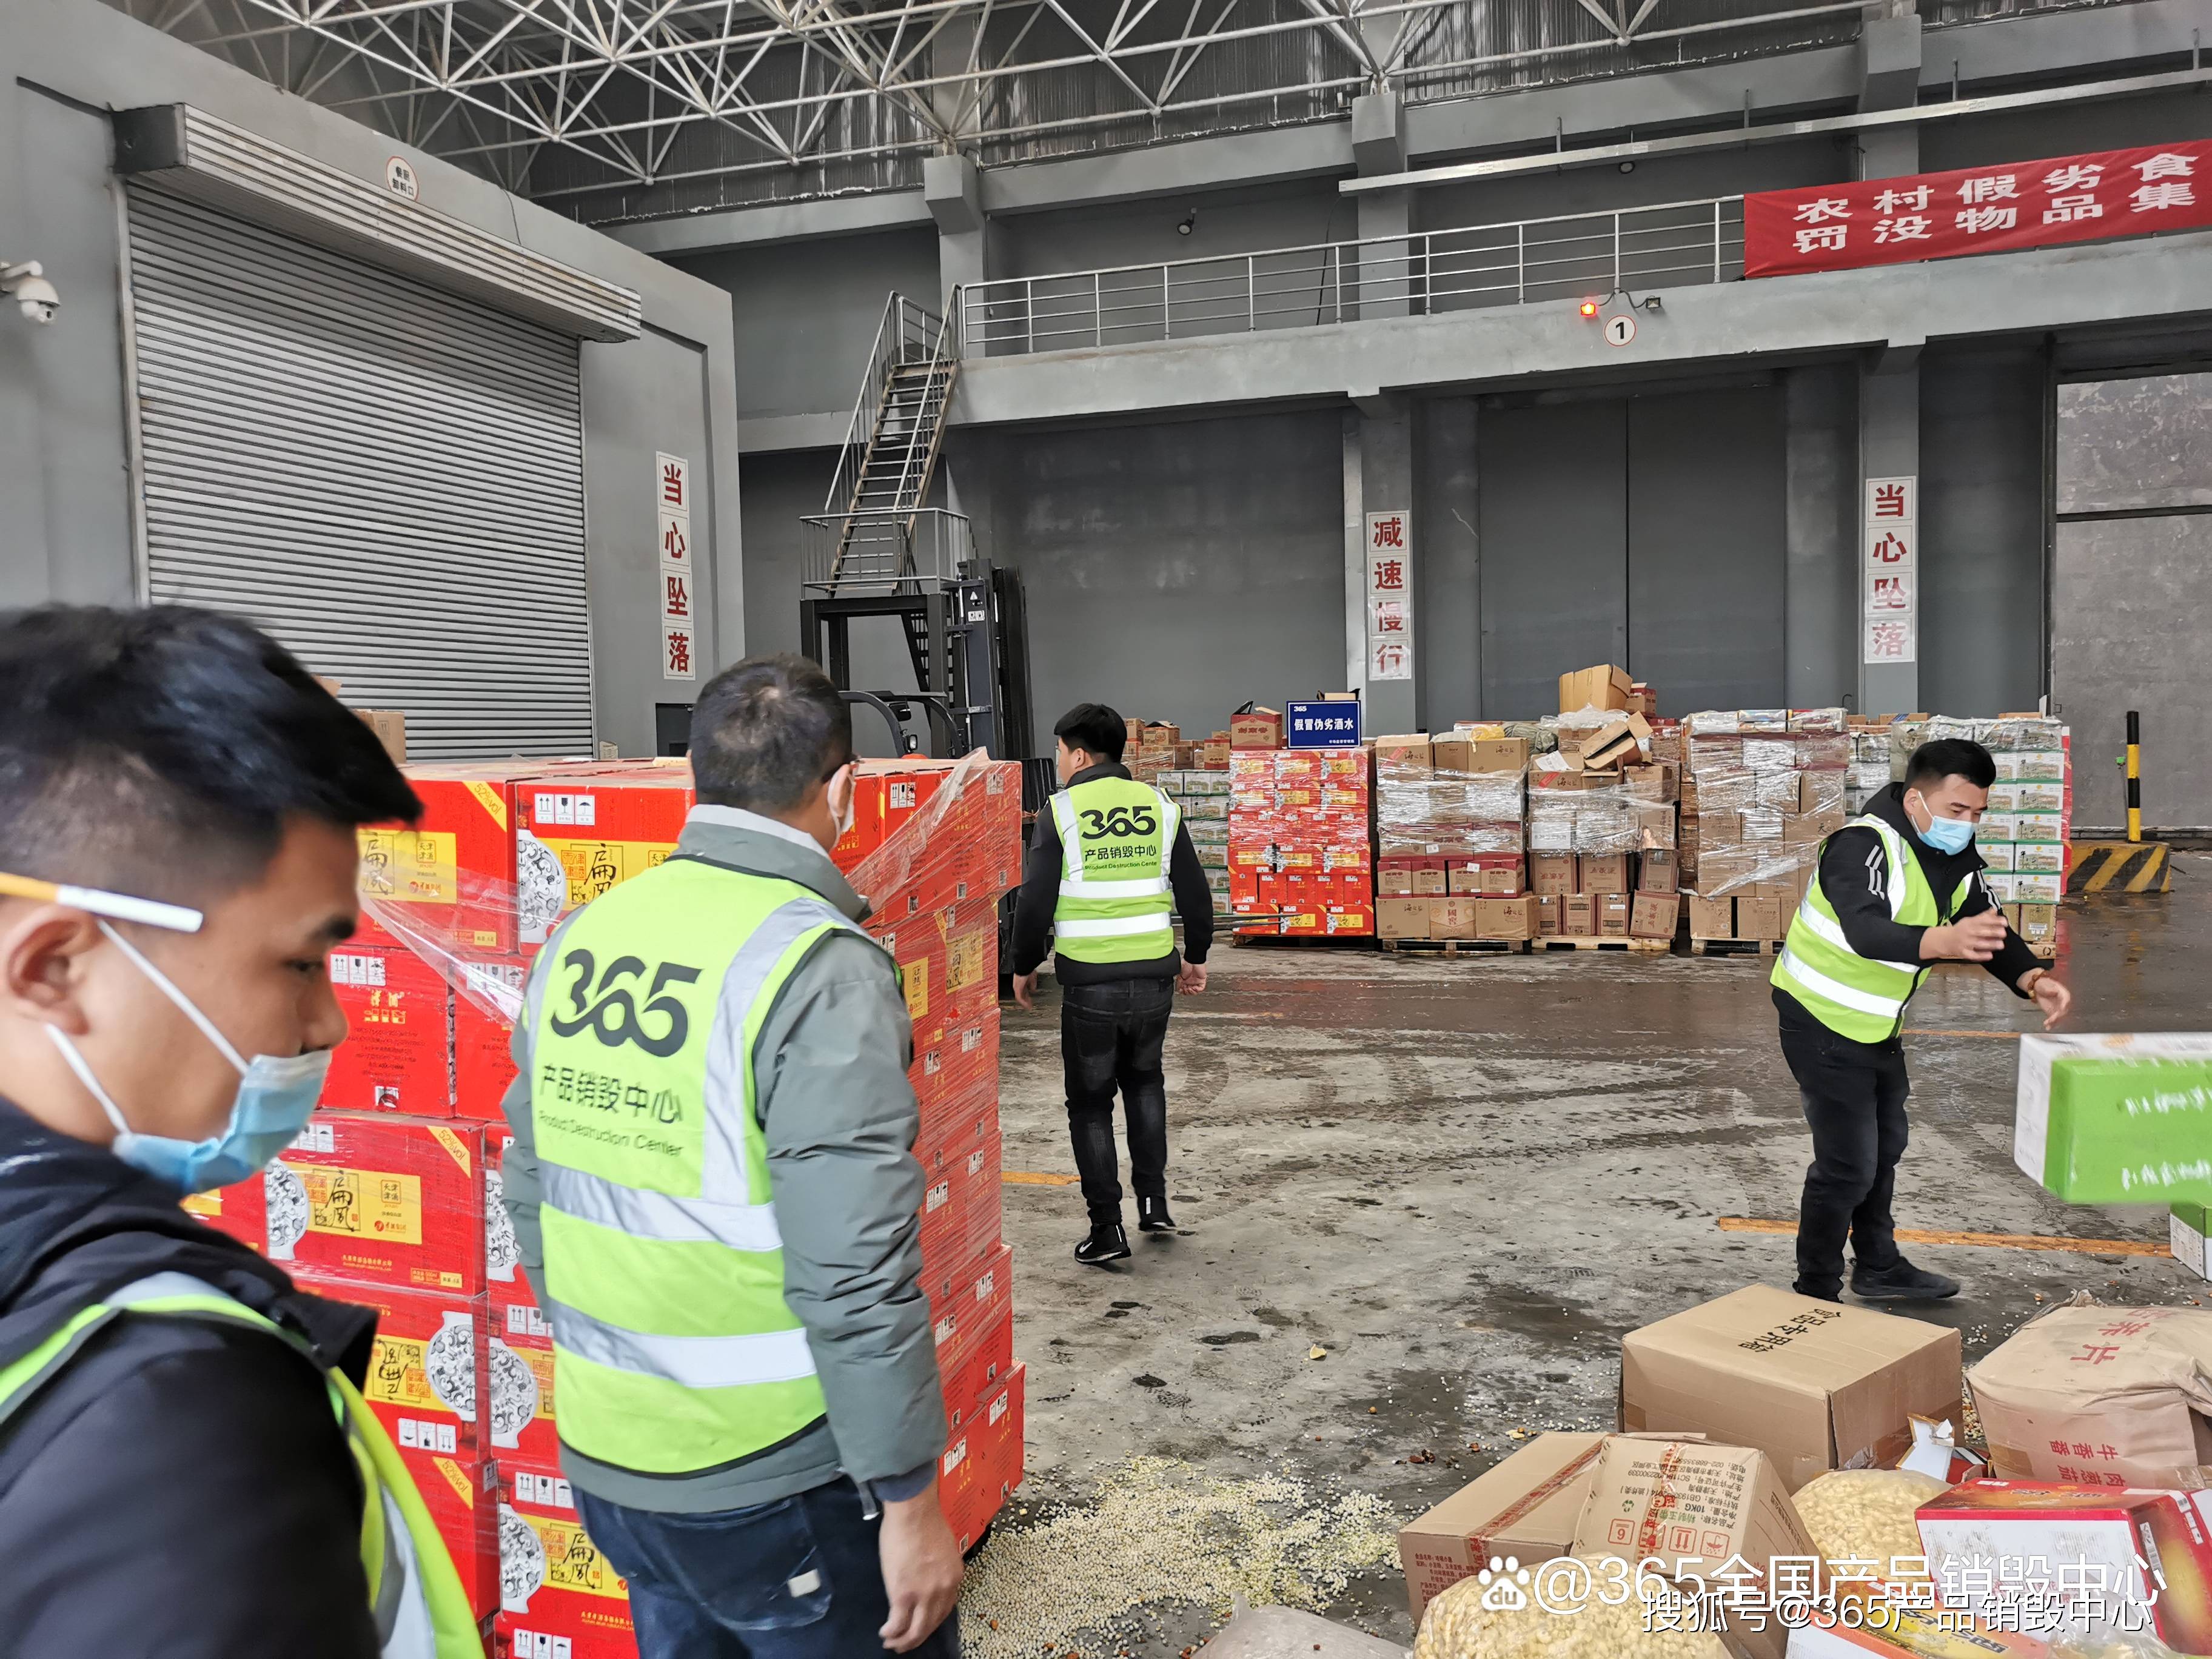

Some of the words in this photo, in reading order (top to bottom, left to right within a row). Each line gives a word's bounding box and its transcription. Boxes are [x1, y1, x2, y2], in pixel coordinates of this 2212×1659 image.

[1792, 153, 2199, 223] 农村假劣食
[1794, 183, 2196, 254] 罚没物品集
[1616, 322, 1624, 340] 1
[665, 463, 689, 673] 当心坠落
[1872, 484, 1907, 656] 当心坠落
[1373, 517, 1403, 674] 减速慢行
[1294, 717, 1353, 731] 假冒伪劣酒水
[474, 783, 503, 816] 52%vol
[1079, 806, 1156, 839] 365
[1085, 845, 1156, 862] 产品销毁中心
[551, 948, 705, 1057] 365
[540, 1064, 684, 1124] 产品销毁中心
[438, 1129, 465, 1161] 52%vol
[1737, 1307, 1844, 1353] 食品专用箱
[441, 1461, 469, 1493] 52%vol
